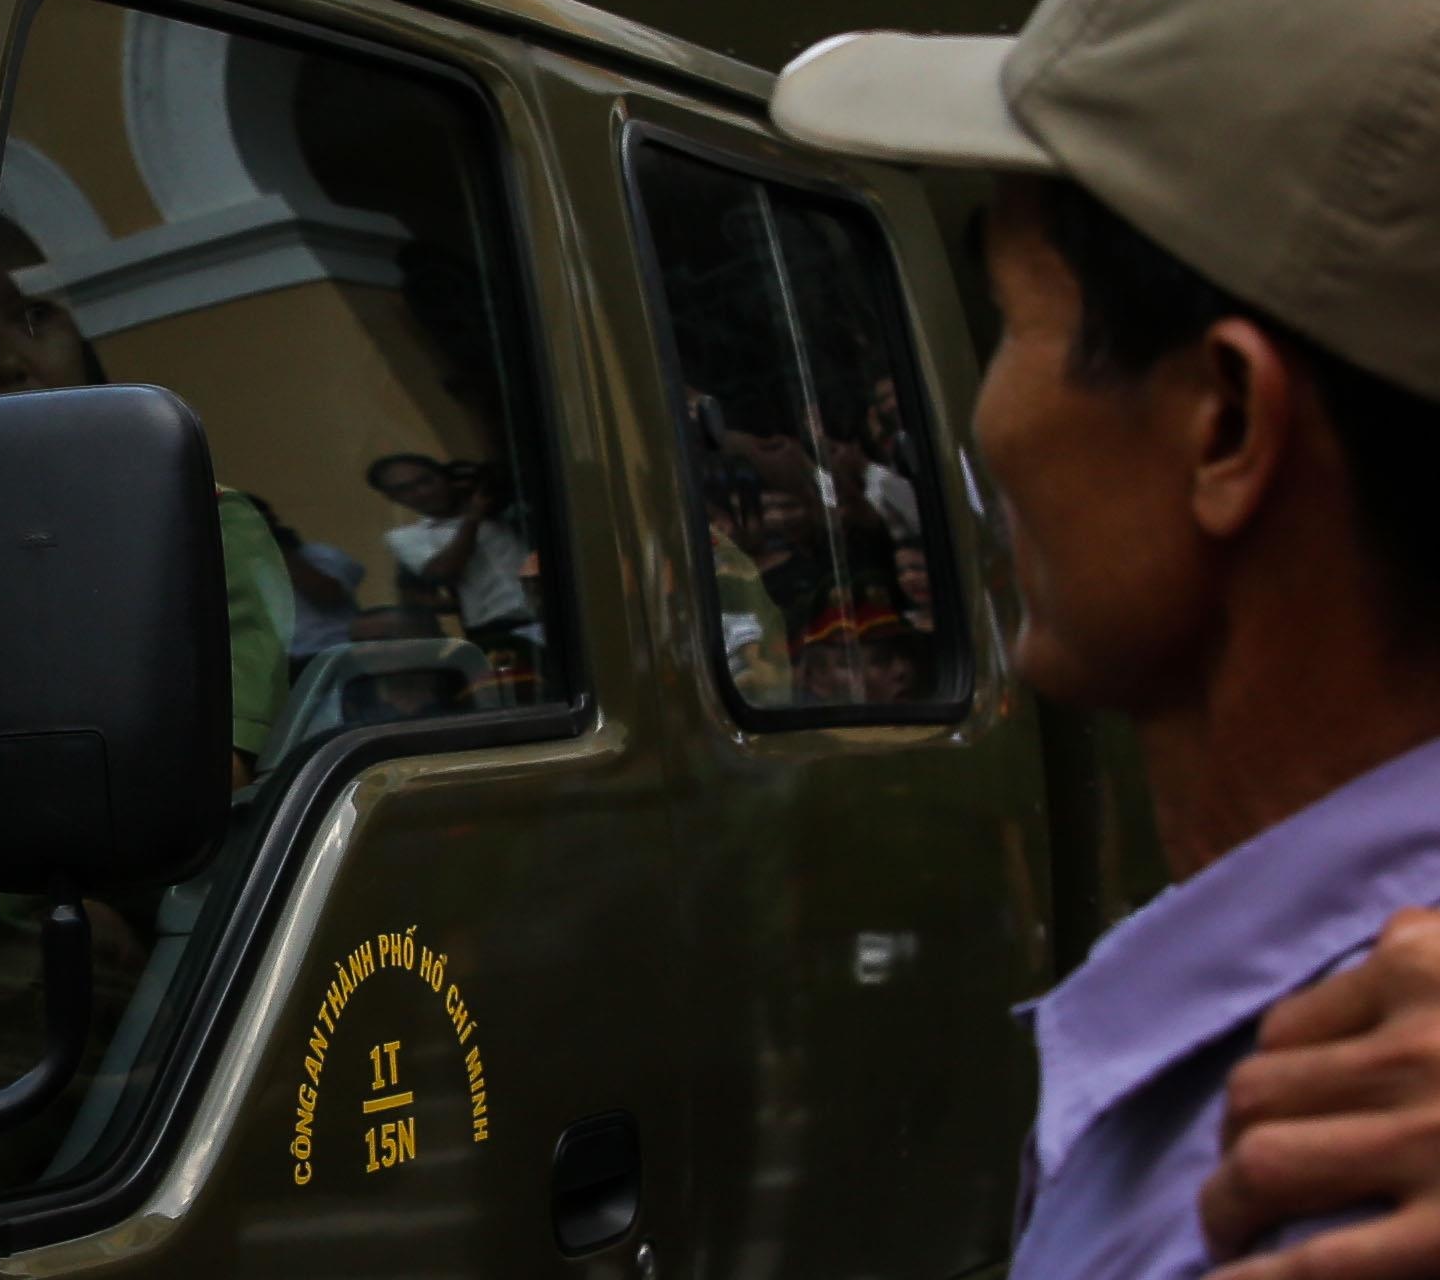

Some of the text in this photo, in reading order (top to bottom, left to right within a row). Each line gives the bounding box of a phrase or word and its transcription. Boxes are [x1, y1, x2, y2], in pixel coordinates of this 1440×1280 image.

[290, 925, 488, 1185] CÔNG AN THÀNH PHỐ HỒ CHÍ MINH
[370, 1041, 400, 1090] 1T
[365, 1117, 416, 1173] 15N
